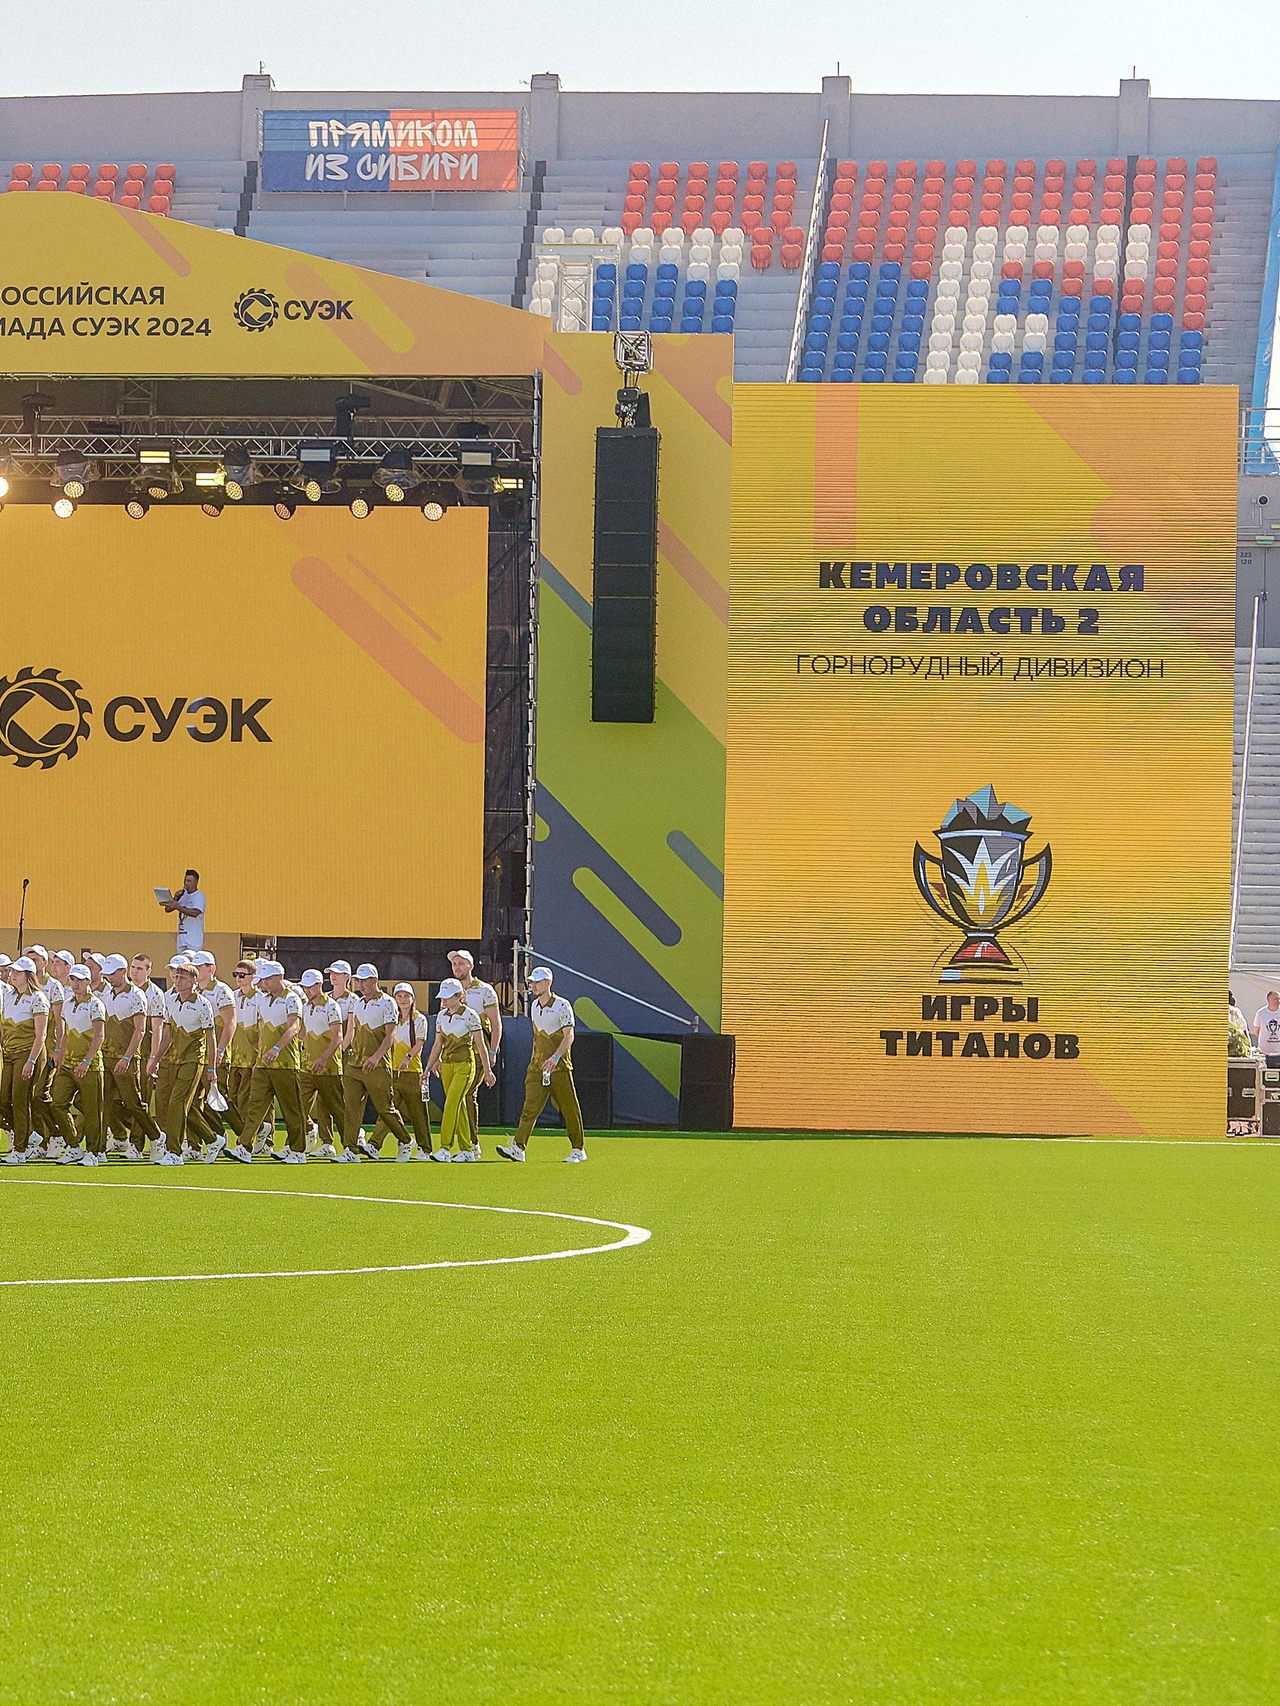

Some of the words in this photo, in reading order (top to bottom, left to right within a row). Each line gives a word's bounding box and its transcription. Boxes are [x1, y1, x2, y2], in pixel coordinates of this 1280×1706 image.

[308, 119, 478, 148] ПРЯМИКОМ
[305, 153, 349, 181] ИЗ
[356, 153, 478, 181] СИБИРИ
[283, 300, 354, 321] СУЭК
[72, 317, 141, 337] СУЭК
[146, 317, 212, 337] 2024
[819, 562, 1145, 592] КЕМЕРОВСКАЯ
[863, 606, 1065, 634] ОБЛАСТЬ
[1077, 608, 1100, 634] 2
[796, 652, 1004, 680] ГОРНОРУДНЫЙ
[1014, 657, 1165, 681] ДИВИЗИОН
[103, 696, 273, 743] СУЭК
[922, 995, 1039, 1022] ИГРЫ
[880, 1030, 1080, 1059] ТИТАНОВ
